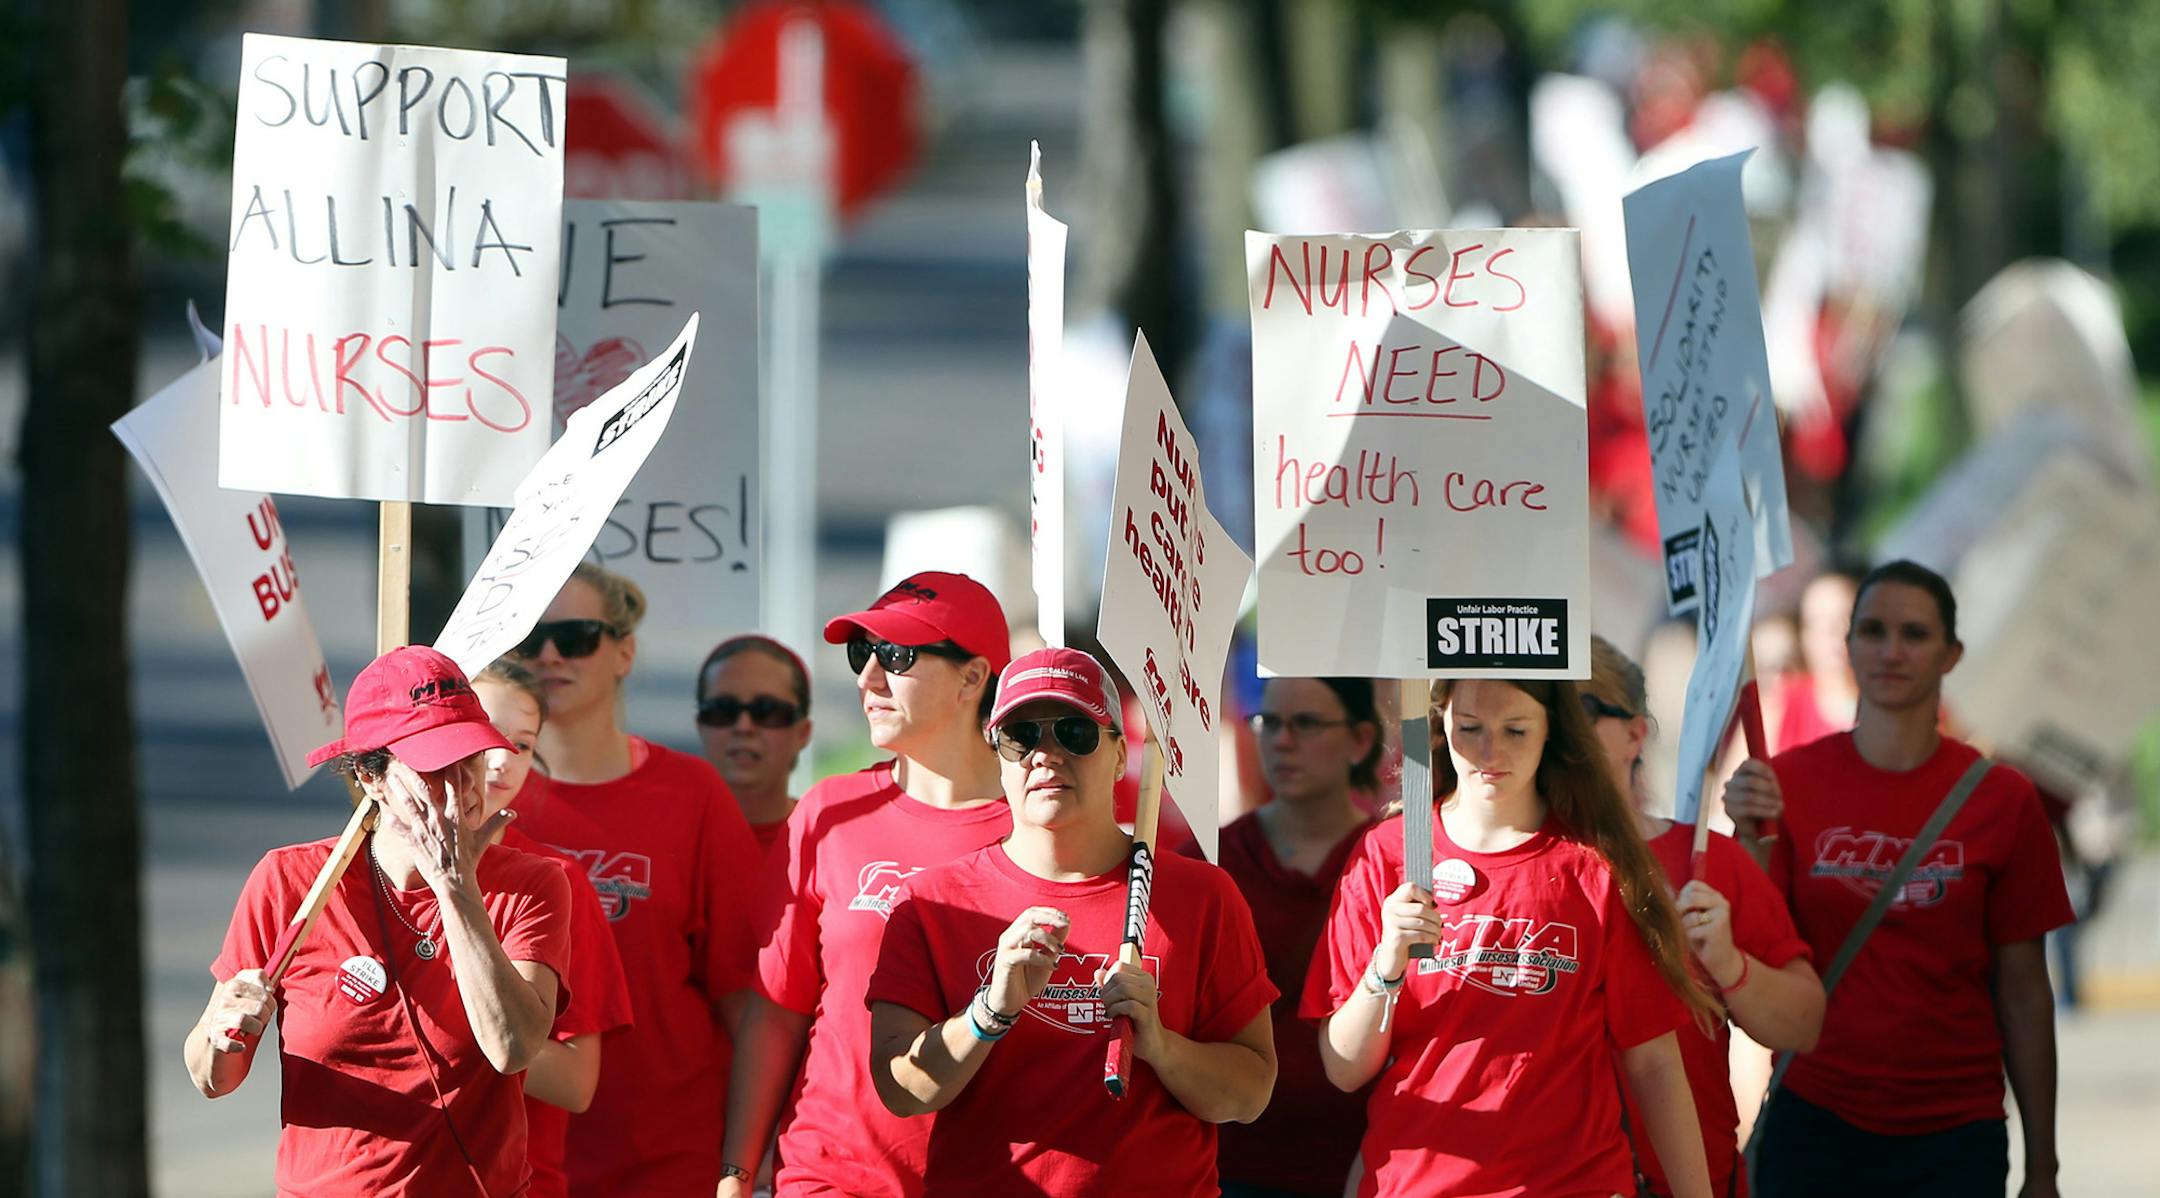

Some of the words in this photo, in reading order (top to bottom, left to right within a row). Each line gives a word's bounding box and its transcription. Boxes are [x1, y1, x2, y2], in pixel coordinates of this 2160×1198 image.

[254, 55, 566, 157] SUPPORT
[229, 184, 533, 277] ALLINA
[1264, 241, 1527, 317] NURSES
[232, 323, 532, 434] NURSES
[1335, 341, 1507, 406] NEED
[1648, 244, 1718, 455] SOLIDARITY
[1150, 457, 1189, 542] put
[1274, 434, 1419, 509] health
[1443, 472, 1548, 512] care
[1286, 518, 1386, 576] too!
[1437, 616, 1559, 655] STRIKE
[1457, 604, 1481, 614] Unfair
[1482, 604, 1506, 614] Labor
[1507, 604, 1539, 614] Practice
[1179, 657, 1211, 733] are
[349, 964, 381, 987] STRIKE
[1042, 986, 1086, 1000] Nurses
[1419, 952, 1475, 973] Minnesot
